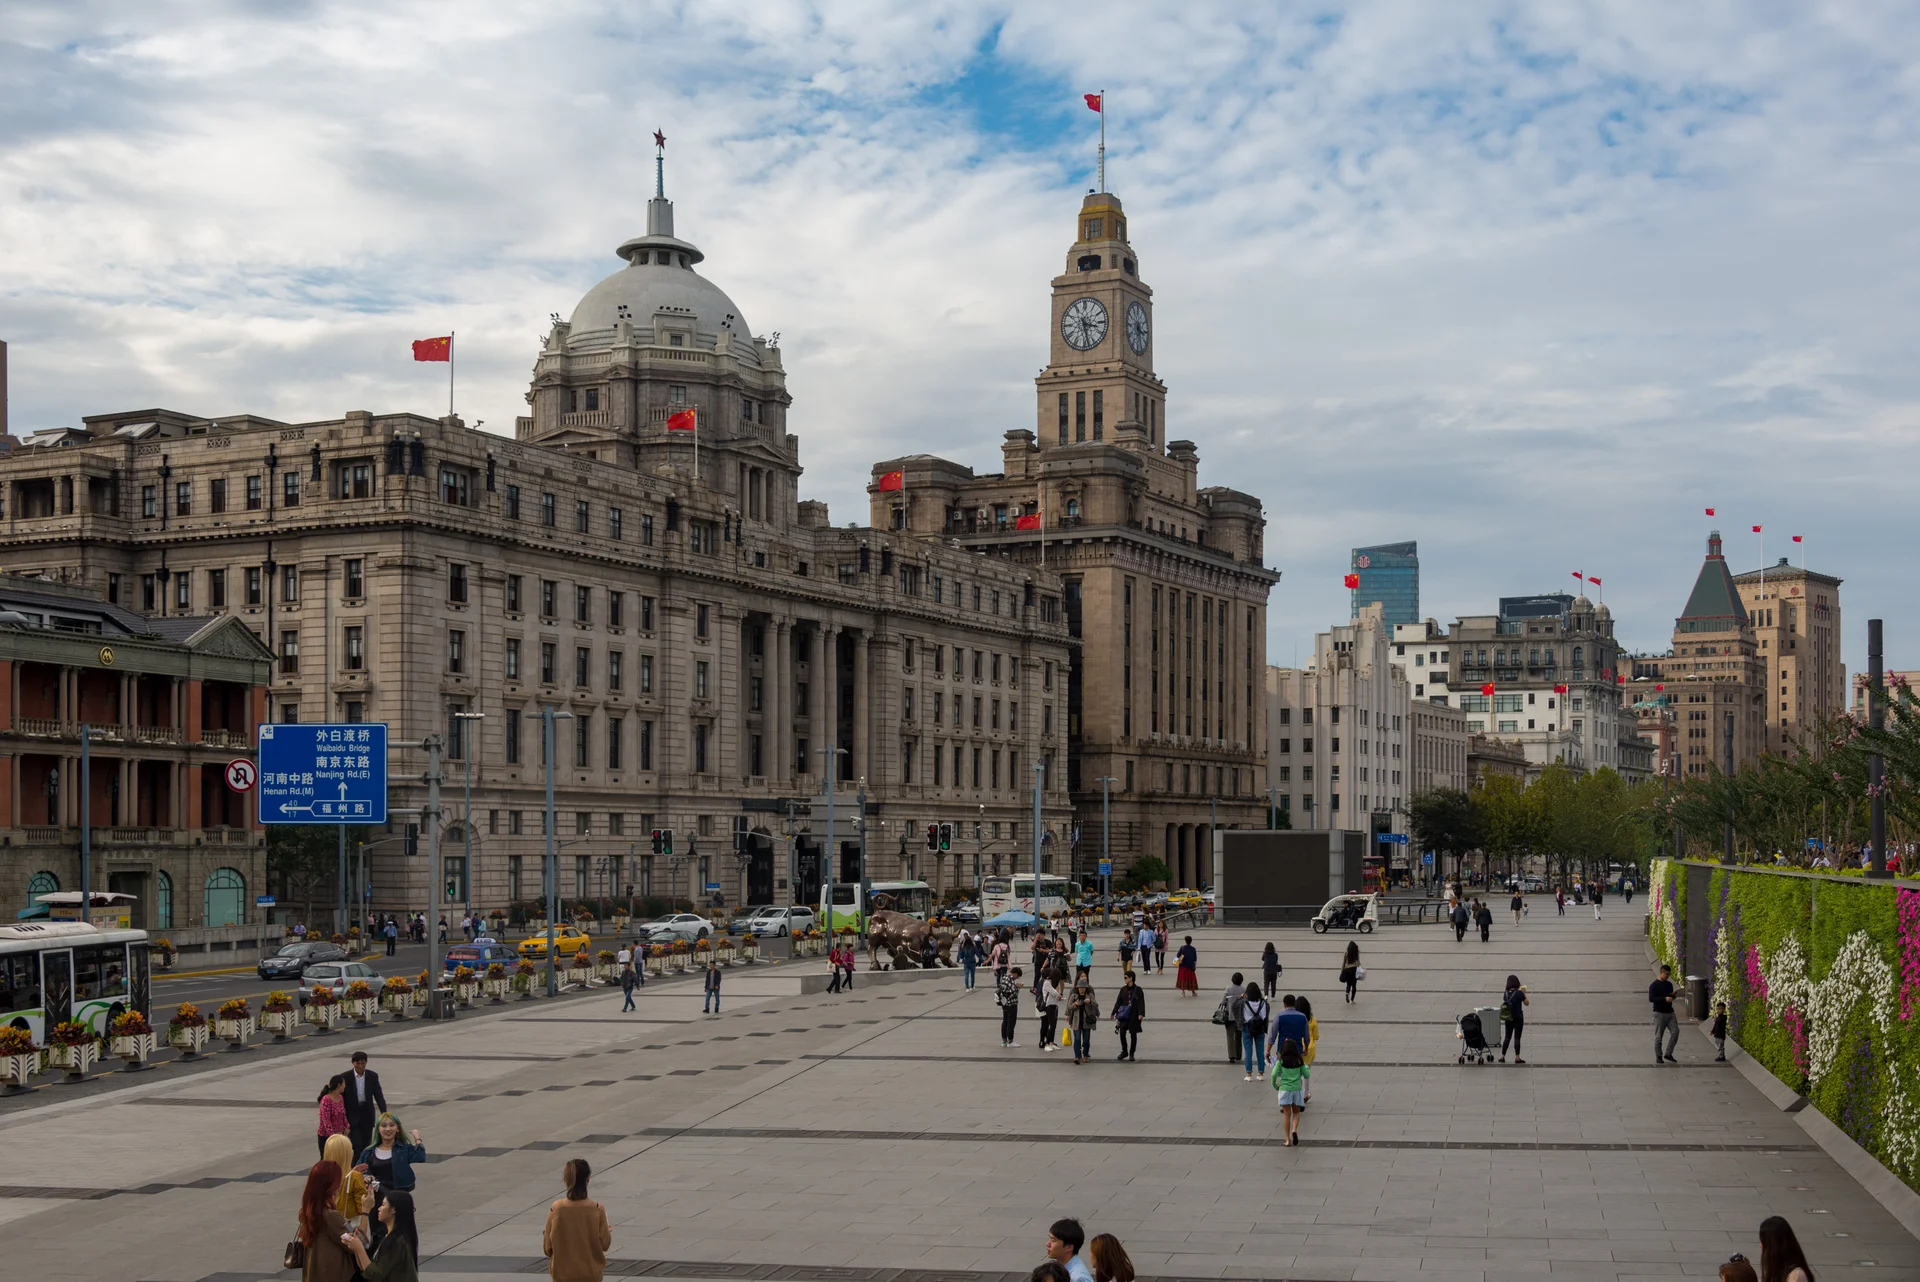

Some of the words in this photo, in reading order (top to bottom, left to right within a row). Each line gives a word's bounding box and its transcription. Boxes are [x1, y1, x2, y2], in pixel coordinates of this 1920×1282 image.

[316, 729, 370, 742] 外白渡桥
[349, 744, 370, 753] Bridge
[316, 756, 370, 768] 南京东路
[263, 773, 314, 785] 河南中路
[316, 771, 344, 779] Nanjing
[348, 771, 370, 779] Rd.(E)
[290, 788, 314, 796] Rd.(M)
[322, 804, 364, 813] 福州路
